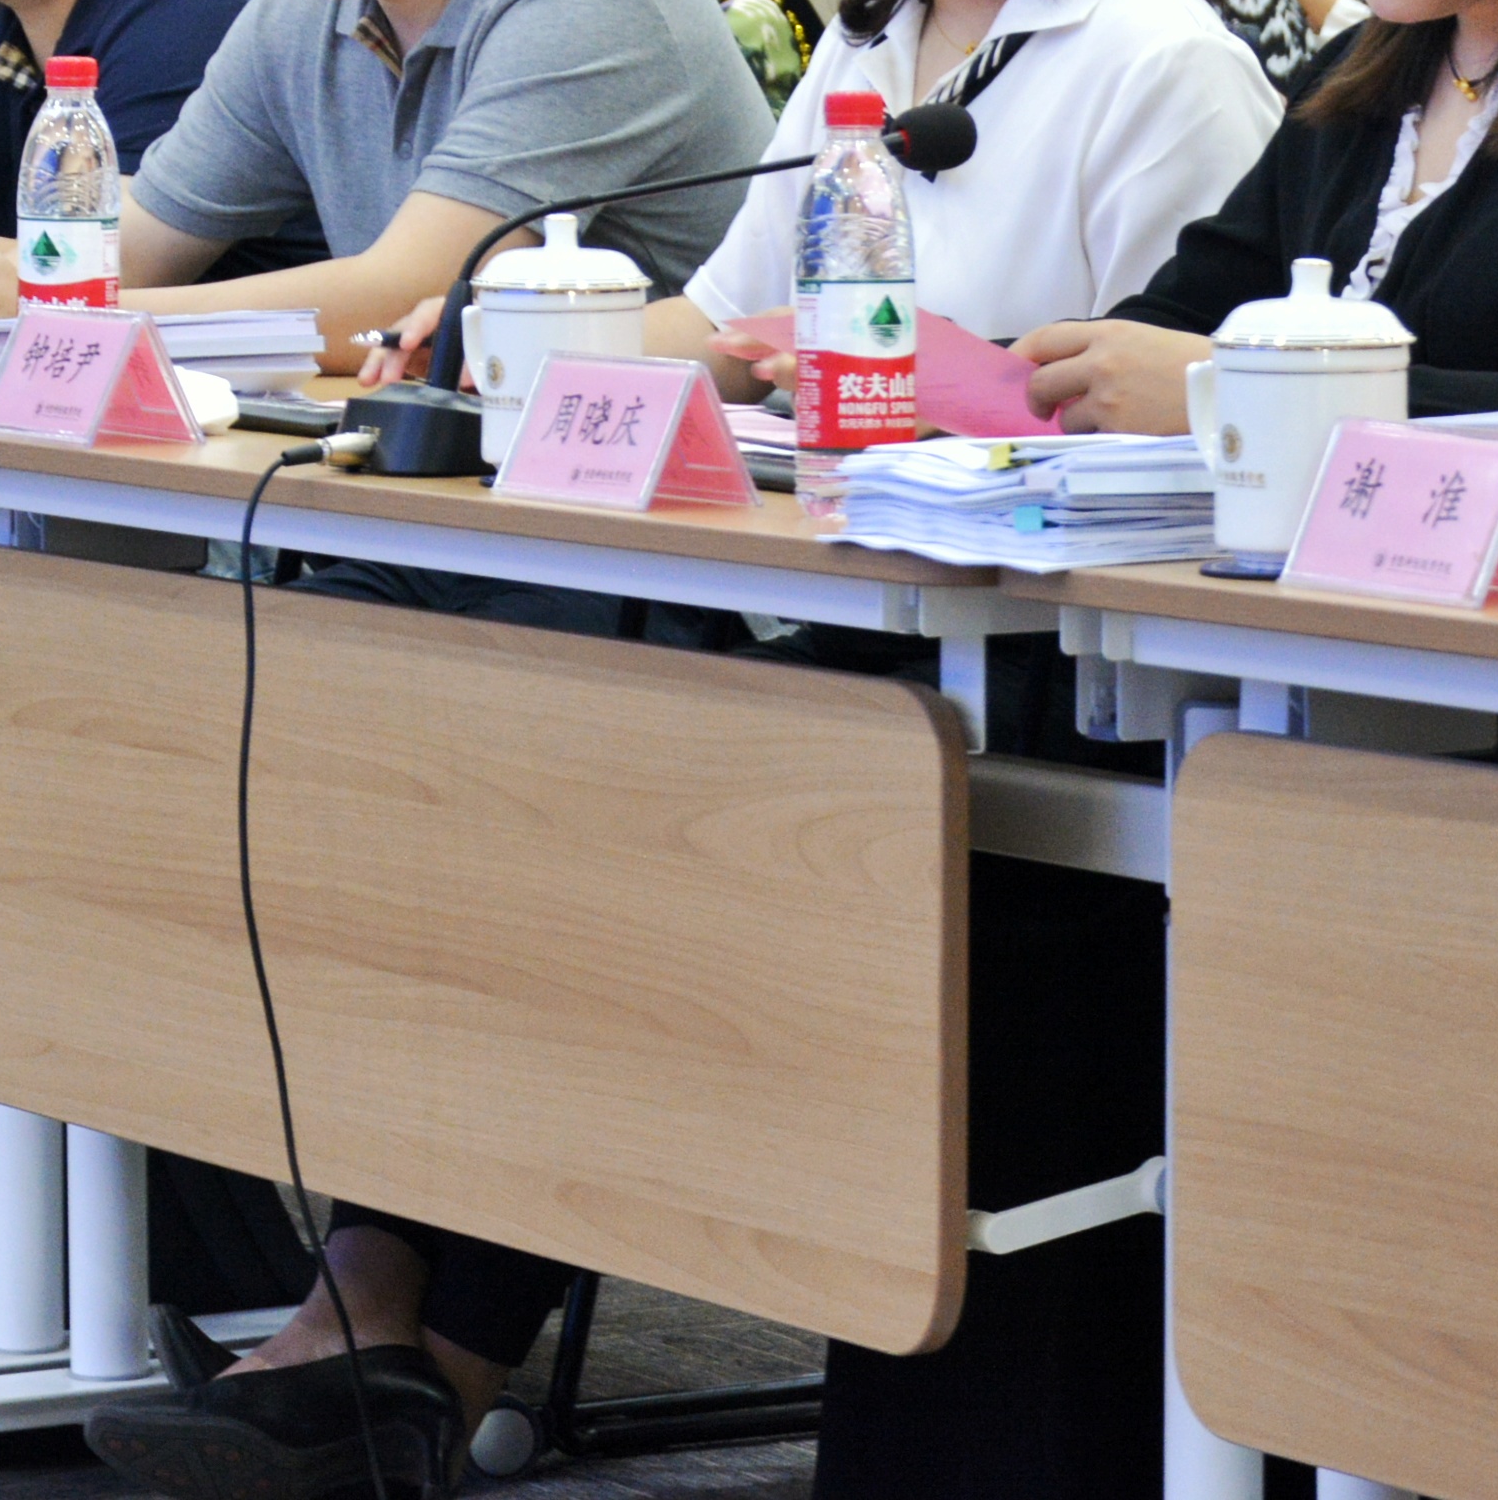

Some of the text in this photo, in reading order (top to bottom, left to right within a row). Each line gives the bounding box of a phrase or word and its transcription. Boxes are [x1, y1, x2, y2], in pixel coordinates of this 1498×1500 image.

[541, 393, 646, 447] 周晓庆
[838, 402, 888, 415] NONGFU
